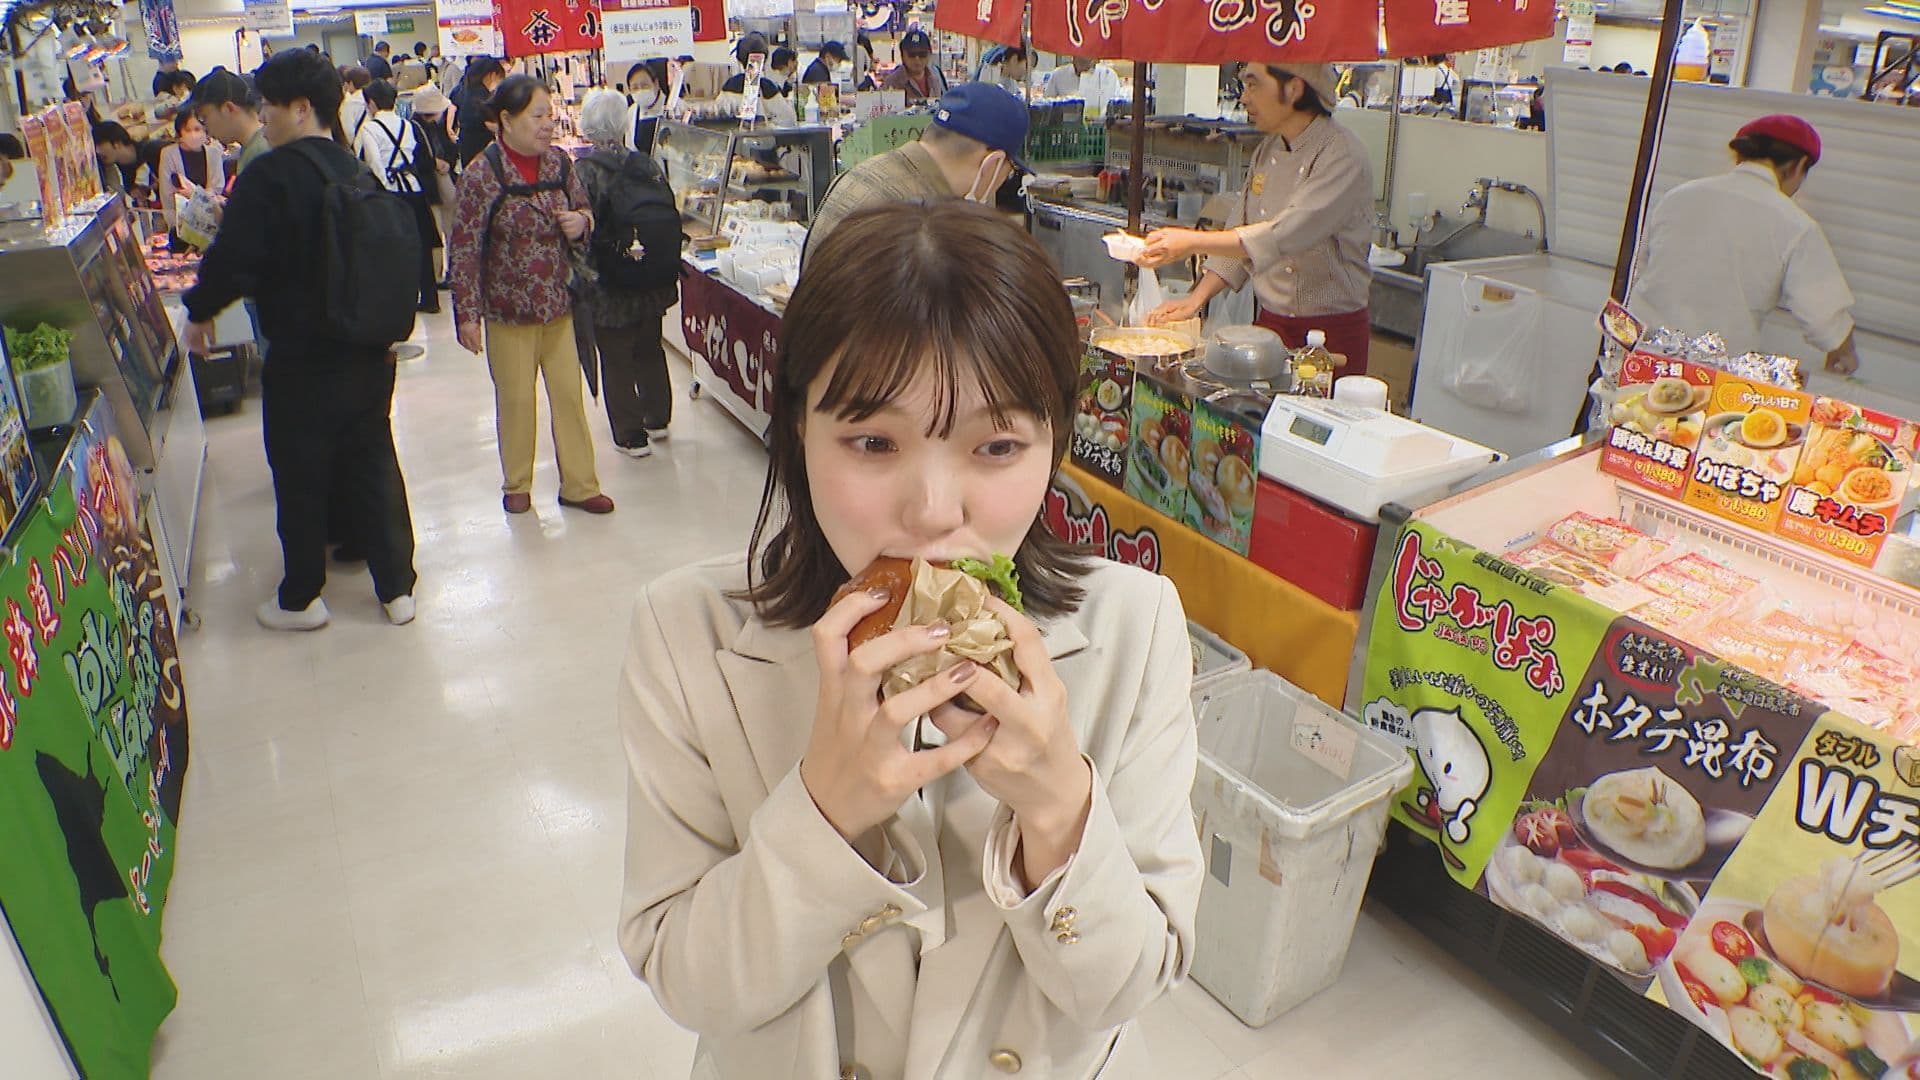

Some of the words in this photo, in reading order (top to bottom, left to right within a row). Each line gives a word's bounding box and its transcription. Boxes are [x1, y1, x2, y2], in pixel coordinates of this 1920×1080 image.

[1654, 361, 1684, 378] 元祖
[1694, 457, 1782, 503] かぼちゃ
[1788, 487, 1887, 536] 豚キムチ
[1620, 631, 1687, 663] 令和元年
[1619, 654, 1675, 683] 生まれ!
[1573, 681, 1778, 787] ホタテ昆布
[1815, 730, 1880, 769] ダブル
